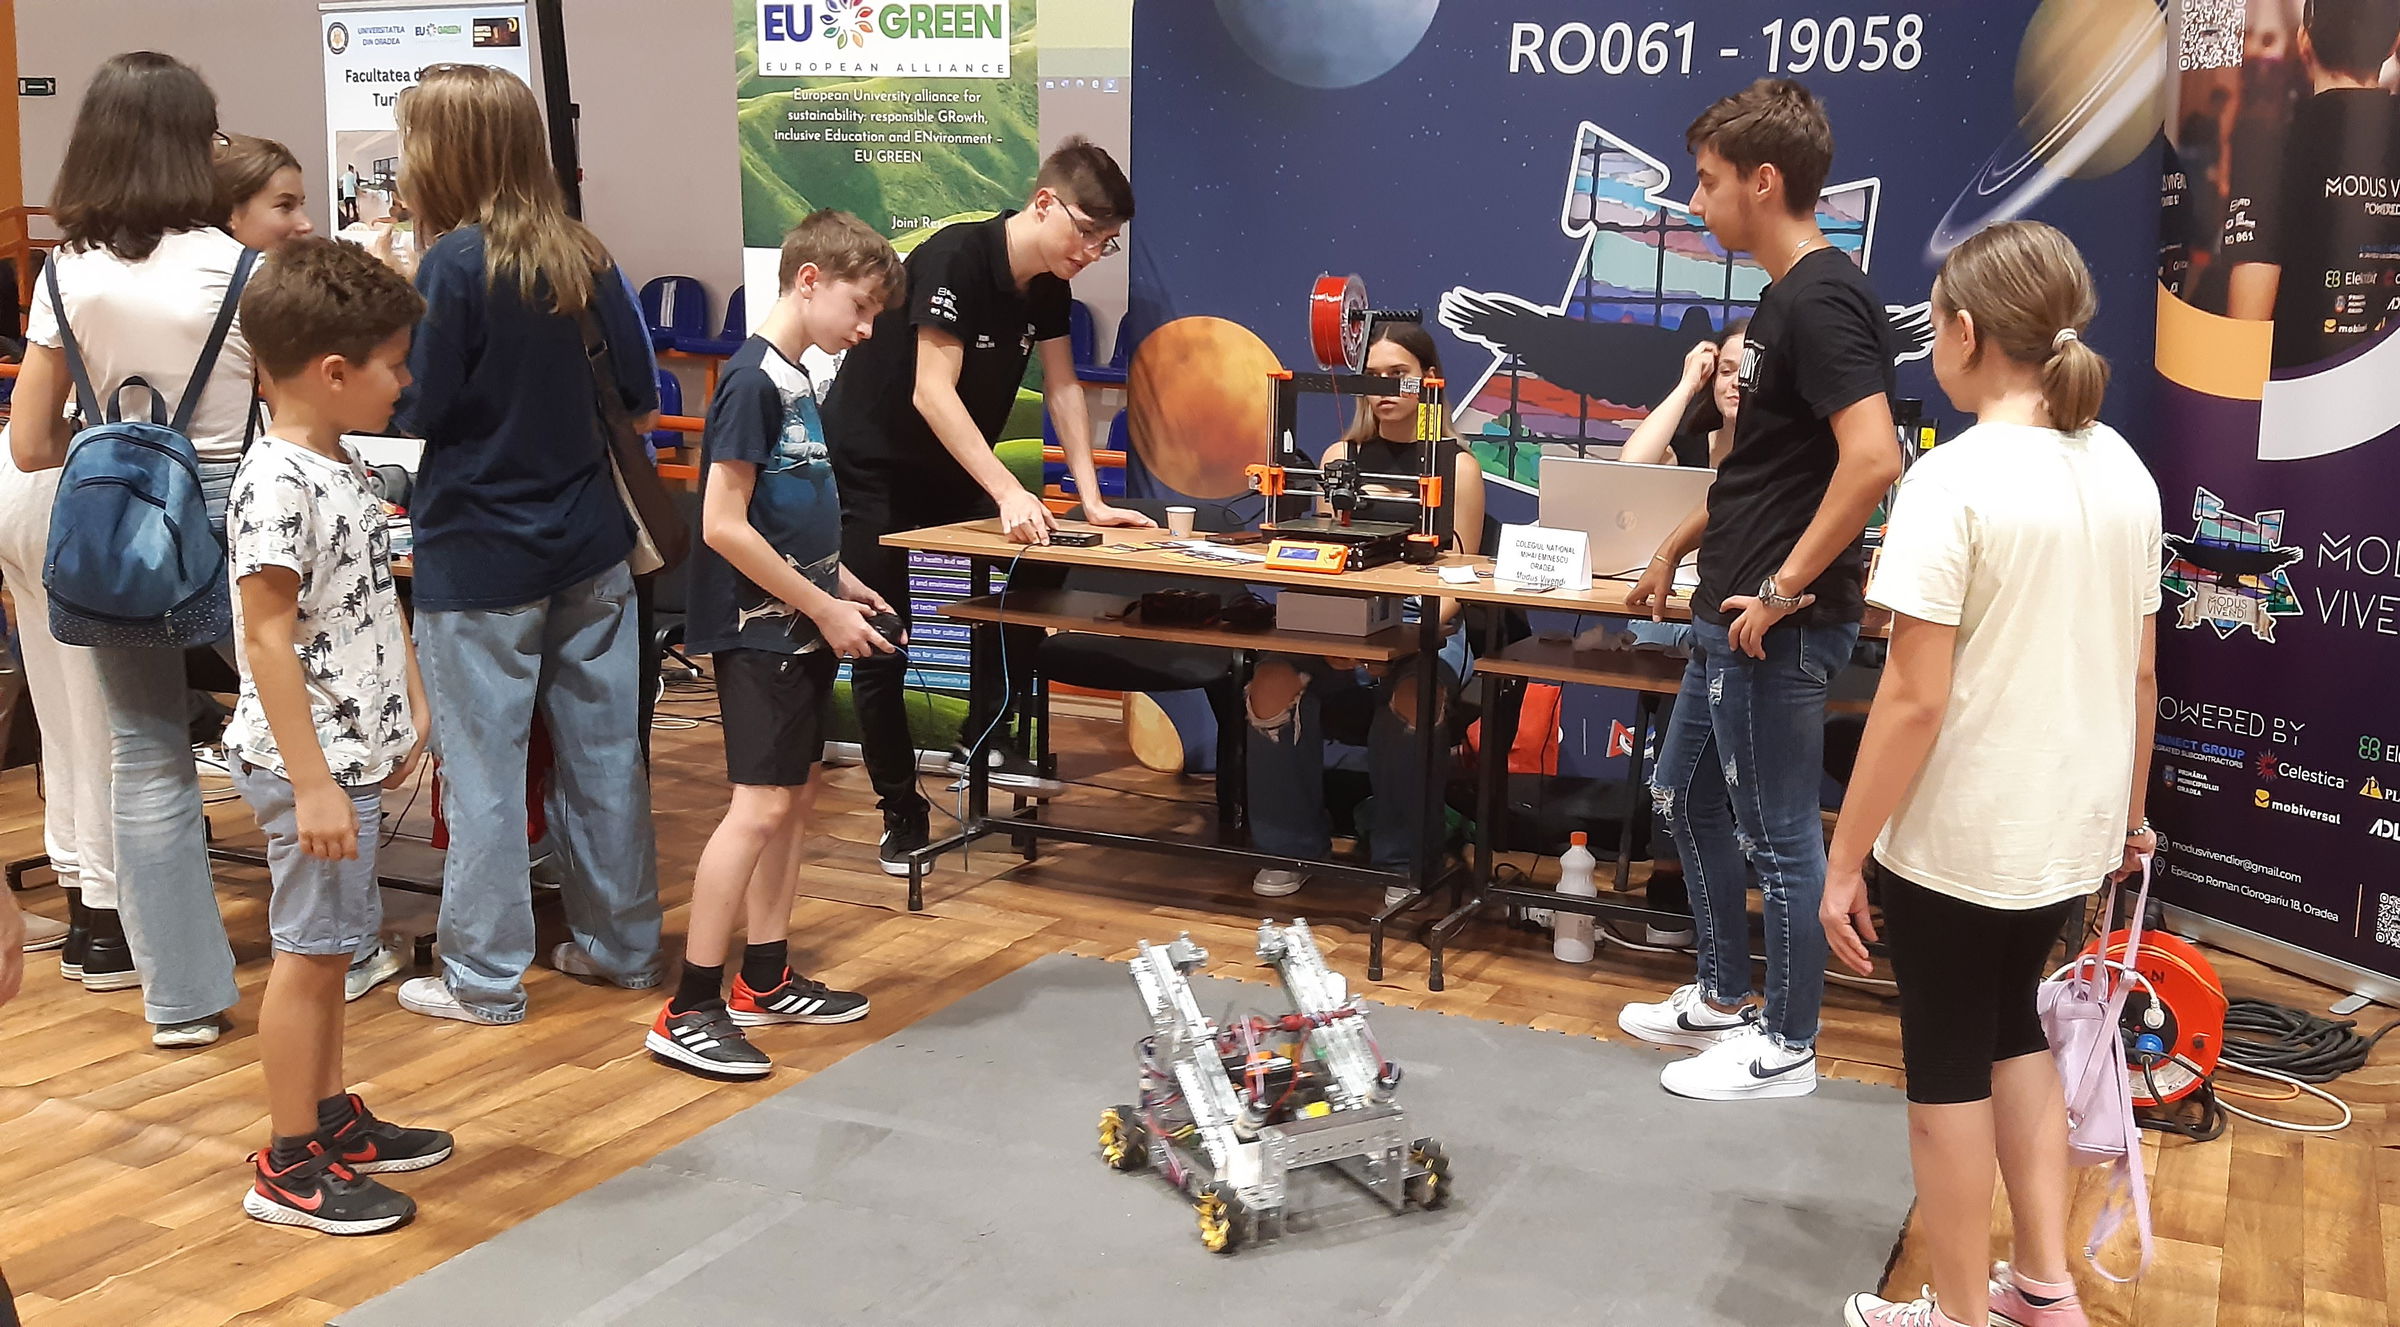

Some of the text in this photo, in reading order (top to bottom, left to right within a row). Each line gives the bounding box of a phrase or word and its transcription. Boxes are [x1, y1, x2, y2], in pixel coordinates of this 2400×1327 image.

[764, 3, 1002, 42] EU GREEN
[1508, 20, 1697, 75] RO061
[1762, 13, 1925, 74] 19058
[345, 67, 411, 83] Facultatea
[766, 62, 1005, 74] EUROPEAN ALLIANCE
[372, 92, 398, 107] Turi
[793, 88, 982, 105] European University alliance for
[787, 108, 989, 125] sustainability: responsible GRowth,
[774, 128, 821, 141] inclusive
[824, 129, 886, 143] Education
[889, 130, 911, 143] and
[914, 131, 993, 144] ENvironment
[854, 149, 922, 163] EU GREEN
[2325, 175, 2387, 198] MODUS
[891, 215, 919, 229] Joint
[2208, 595, 2247, 609] MODUS
[2208, 605, 2247, 618] VIVENDI
[2316, 587, 2400, 635] VIVE
[2159, 696, 2305, 745] OWERED BY
[2201, 743, 2245, 759] GROUP
[2278, 762, 2345, 789] Celestica
[2272, 801, 2341, 825] mobiversal
[2171, 865, 2205, 884] Episcop
[2206, 875, 2240, 894] Roman
[2303, 903, 2339, 923] Oradea
